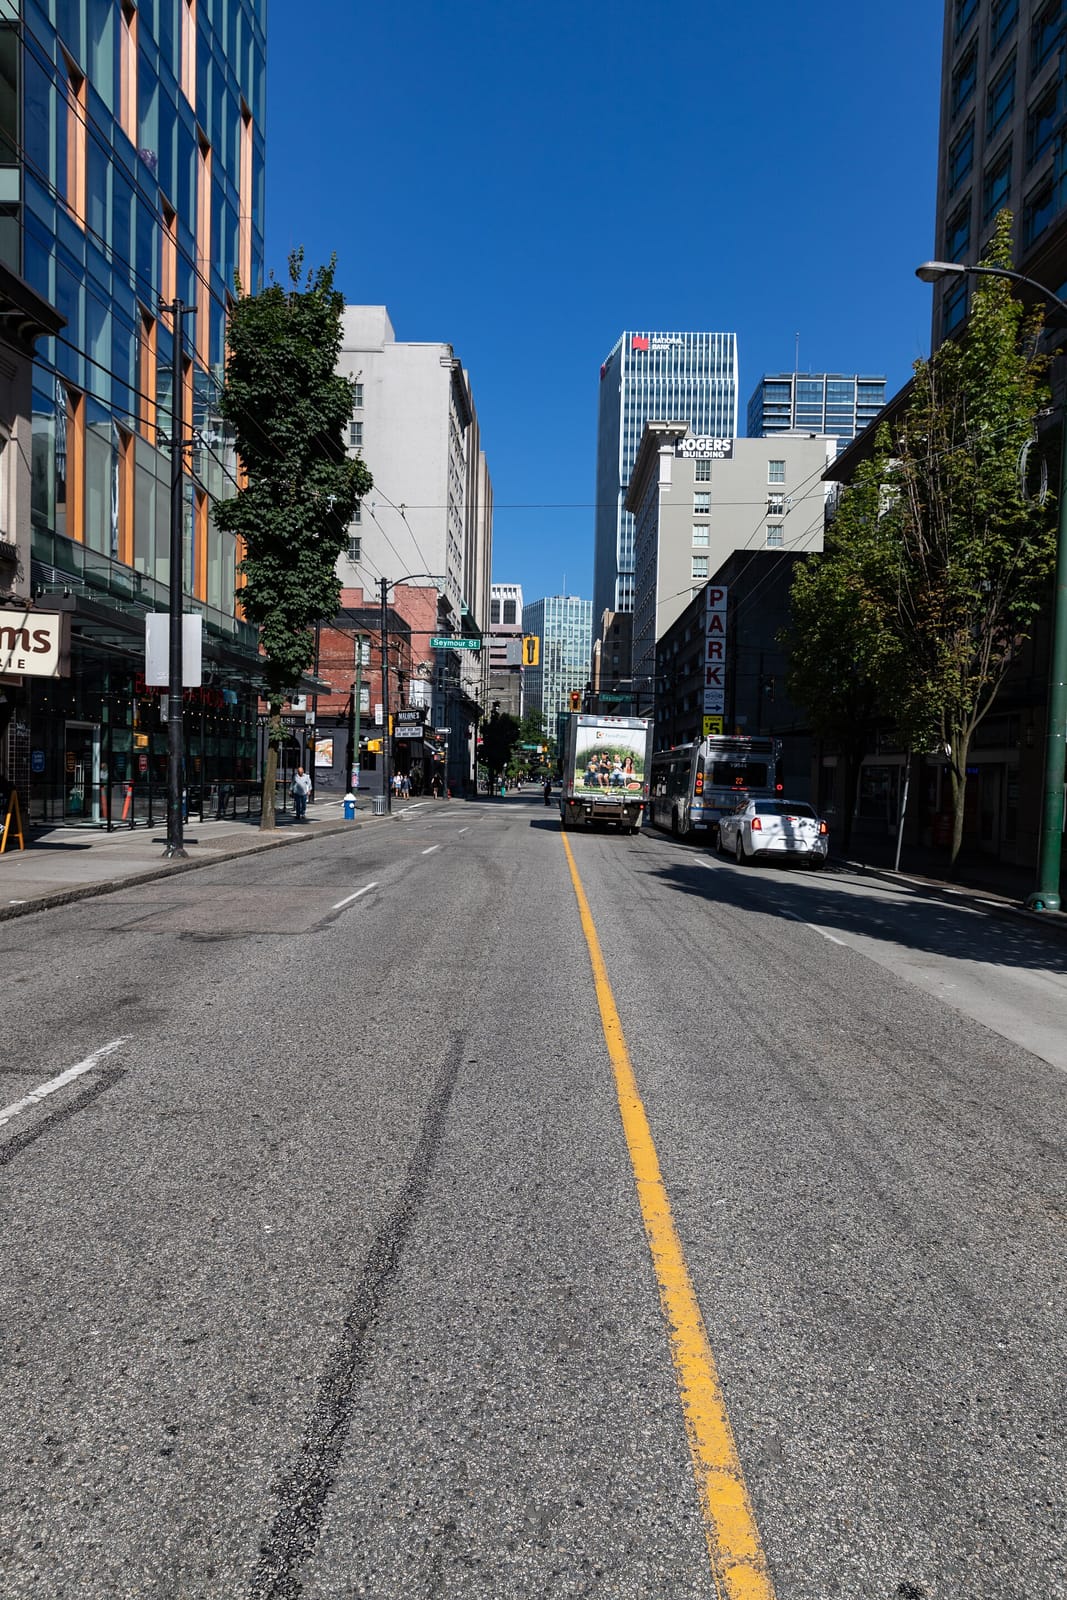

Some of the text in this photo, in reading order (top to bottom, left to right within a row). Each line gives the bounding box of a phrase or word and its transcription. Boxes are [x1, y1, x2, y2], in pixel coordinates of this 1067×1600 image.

[677, 438, 731, 451] ROGERS
[433, 639, 465, 647] Seymour
[706, 589, 724, 685] PARK
